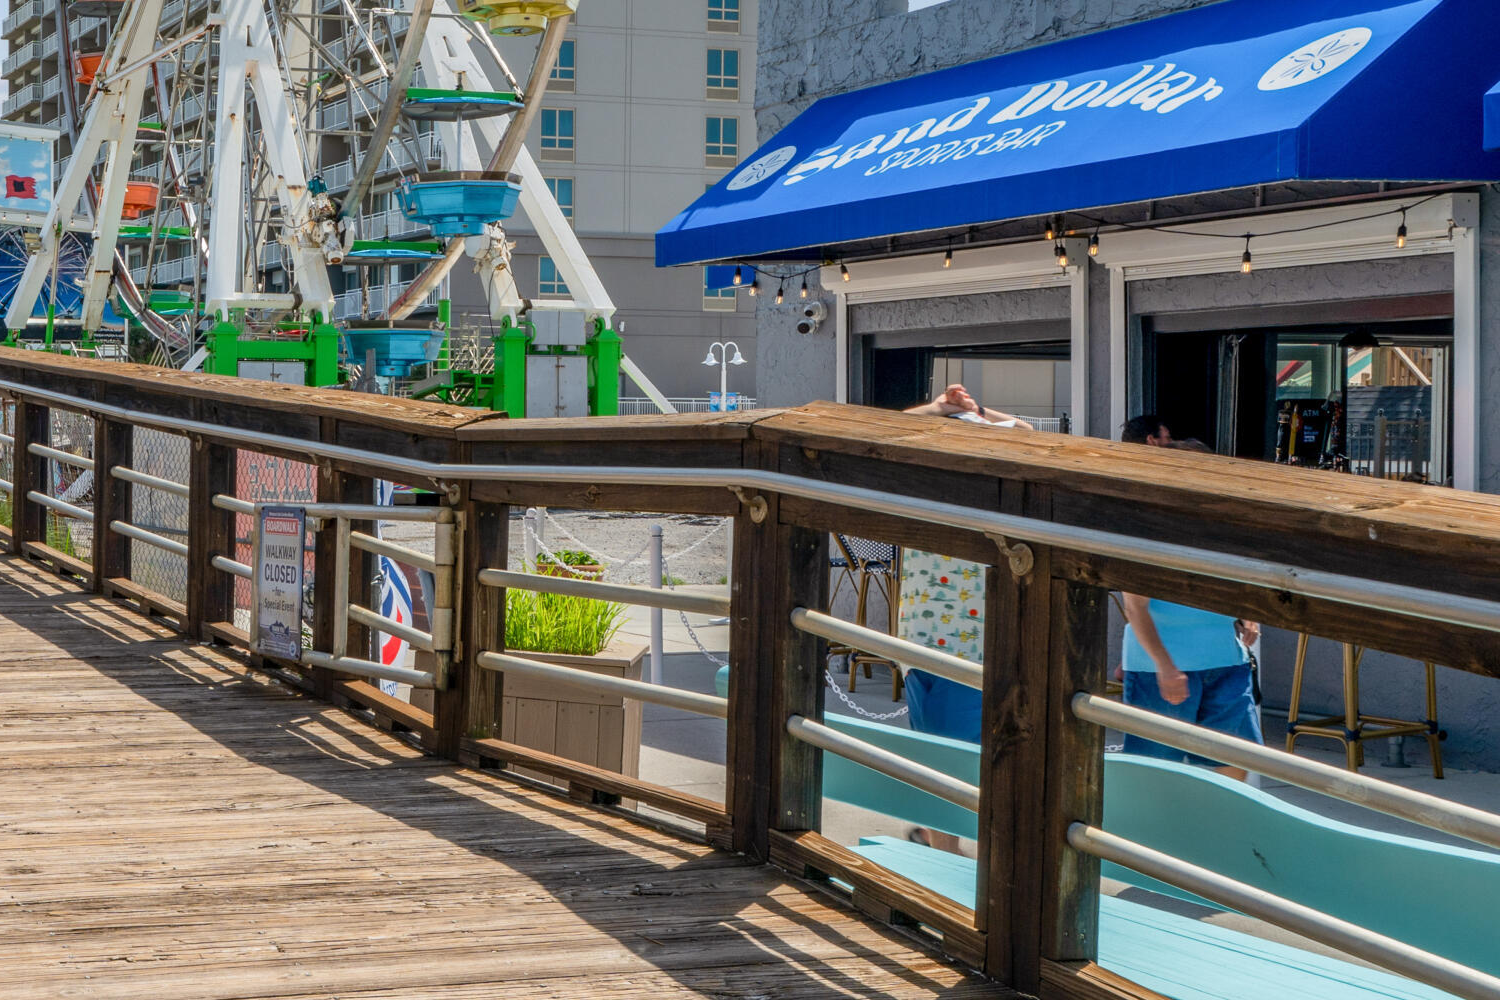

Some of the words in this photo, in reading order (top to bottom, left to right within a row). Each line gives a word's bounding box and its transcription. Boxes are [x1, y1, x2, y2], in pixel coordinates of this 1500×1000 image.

[783, 96, 990, 185] Sand
[987, 63, 1223, 124] Dollar
[864, 132, 995, 176] SPORTS
[976, 120, 1066, 155] BAR
[1302, 409, 1320, 417] ATM
[266, 520, 297, 533] BOARDWALK
[265, 544, 297, 561] WALKWAY
[264, 563, 297, 585] CLOSED
[264, 597, 281, 611] Special
[281, 600, 295, 612] Event
